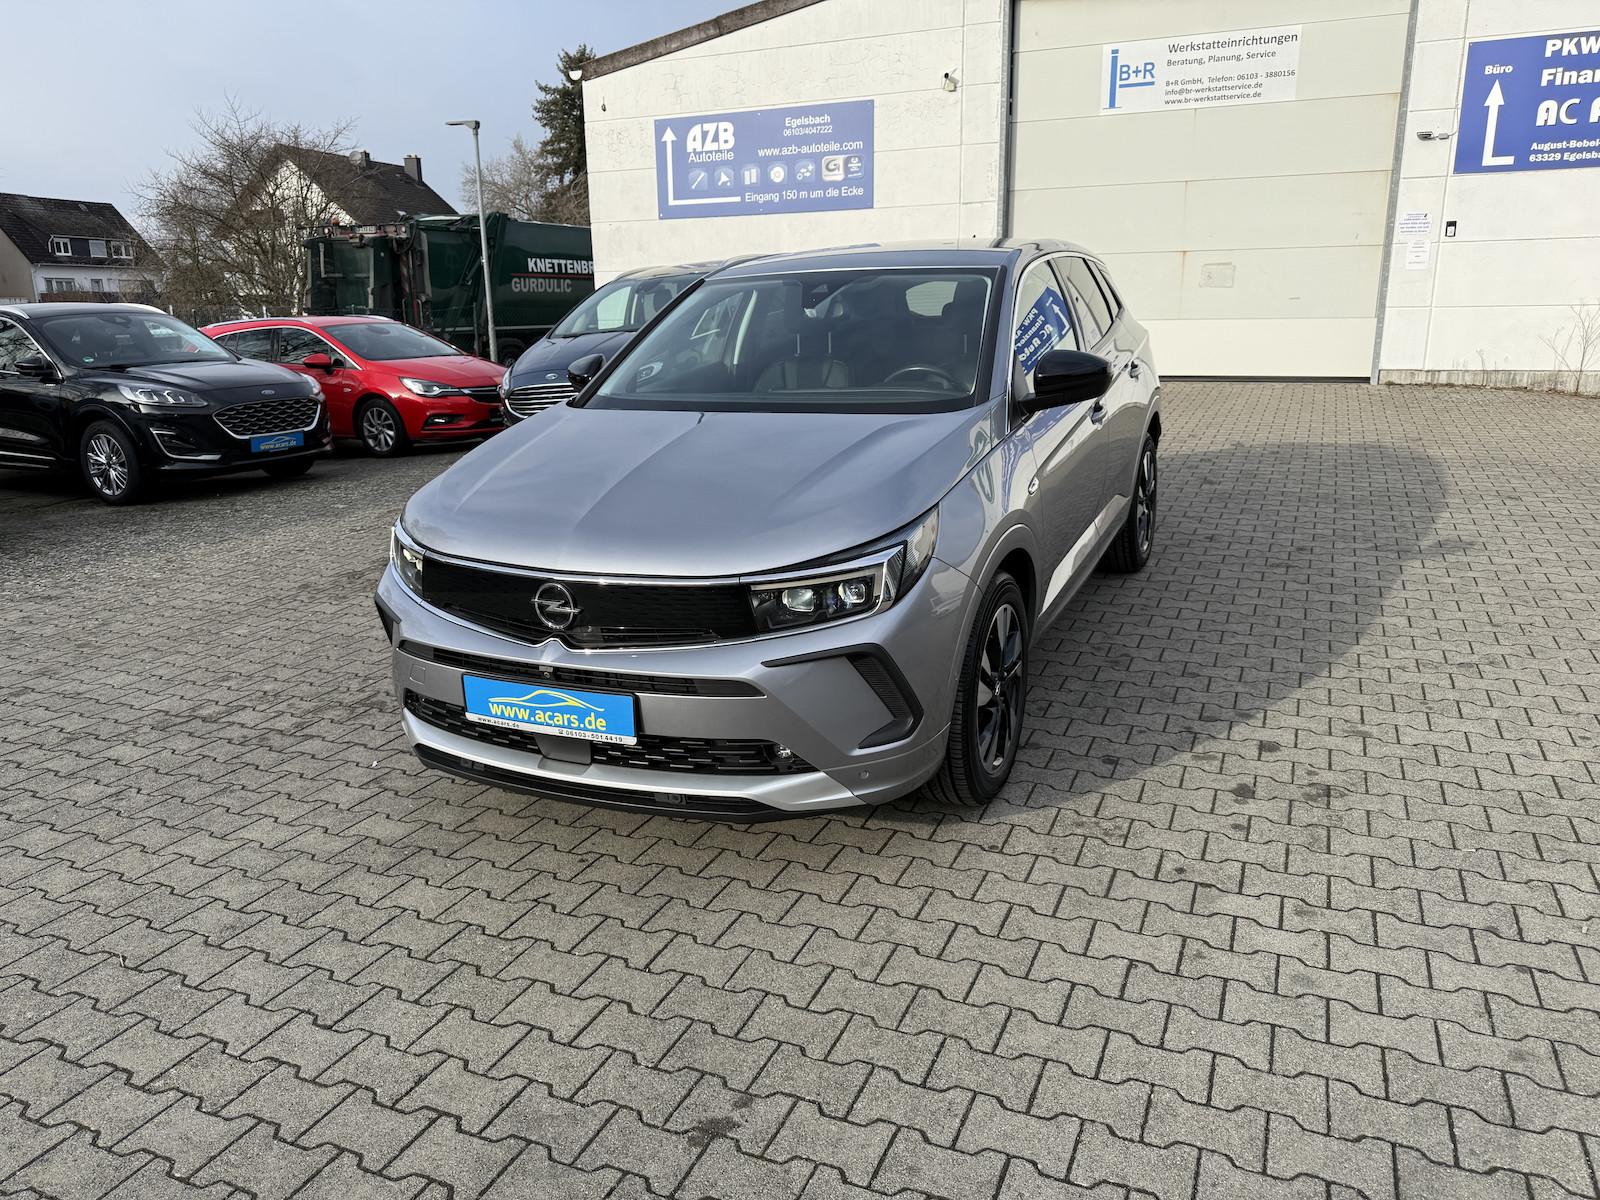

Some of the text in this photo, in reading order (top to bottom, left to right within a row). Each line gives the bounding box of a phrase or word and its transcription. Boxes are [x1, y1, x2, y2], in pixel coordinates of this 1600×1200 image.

[1168, 32, 1298, 53] Werkstatteinrichtungen
[1545, 36, 1600, 57] PKW
[1167, 49, 1277, 67] Beratung, Planung, Service
[1484, 64, 1513, 75] Büro
[1165, 79, 1179, 87] B+R
[1180, 76, 1204, 86] GmbH,
[1208, 74, 1236, 84] Telefon:
[1237, 72, 1258, 81] 06103
[1265, 69, 1296, 79] 3880156
[1165, 81, 1263, 96] info@br-werkstattservice.de
[1164, 91, 1262, 105] www.br-werkstattservice.de
[1536, 98, 1581, 127] AC
[785, 114, 831, 128] Egelsbach
[686, 121, 735, 153] AZB
[783, 125, 833, 137] 06103/4047222
[758, 140, 863, 157] www.azb-autoteile.com
[688, 150, 735, 164] Autoteile
[1529, 153, 1561, 162] 63329
[745, 186, 864, 204] Eingang 150 m um die Ecke
[511, 277, 572, 293] GURDULIC
[477, 717, 521, 728] www.acars.de
[489, 702, 607, 731] www.acars.de
